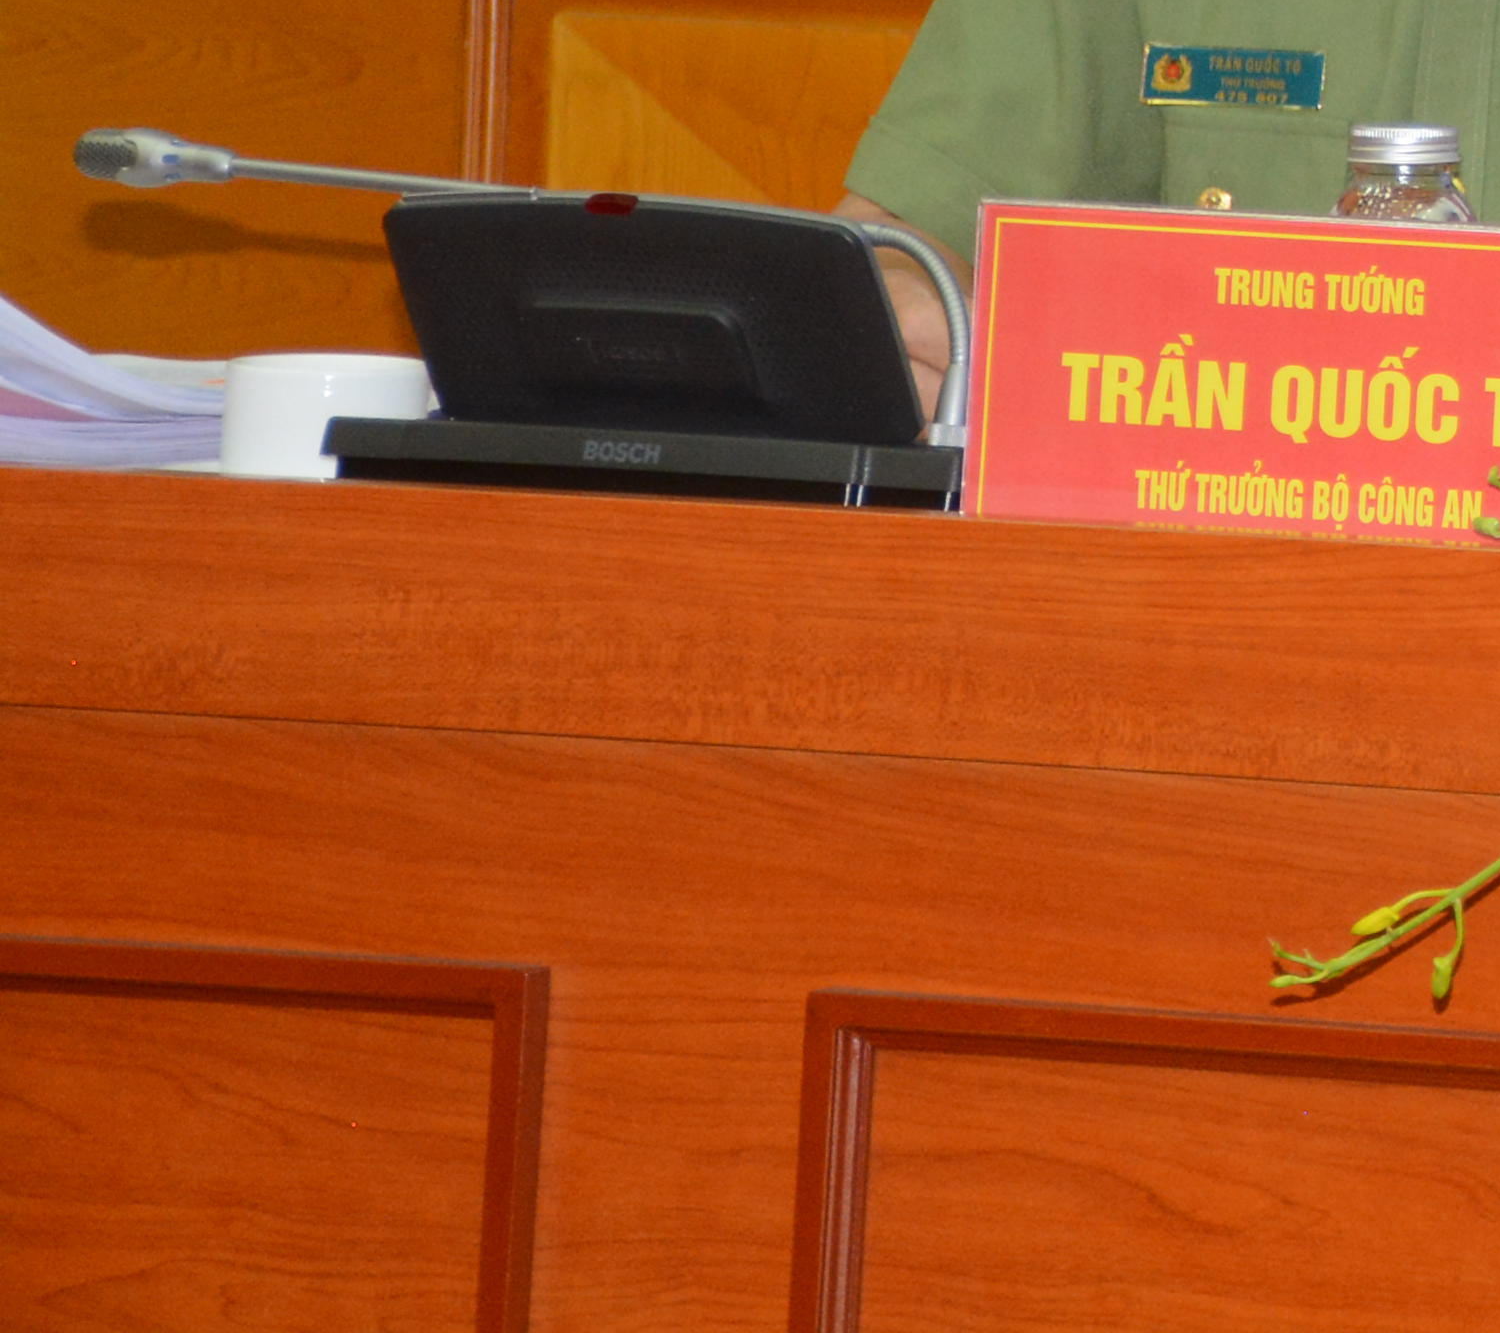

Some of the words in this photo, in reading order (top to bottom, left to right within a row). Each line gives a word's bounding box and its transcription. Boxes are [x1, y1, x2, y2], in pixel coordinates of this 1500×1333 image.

[1214, 268, 1314, 310] TRUNG
[1325, 266, 1425, 316] TƯỚNG
[1062, 334, 1246, 431] TRẦN
[1270, 347, 1460, 444] QUỐC
[583, 440, 661, 464] BOSCH
[1135, 461, 1190, 512] THỨ
[1196, 460, 1303, 519] TRƯỞNG
[1312, 473, 1349, 531] BỘ
[1358, 476, 1434, 526] CÔNG
[1442, 489, 1483, 530] AN
